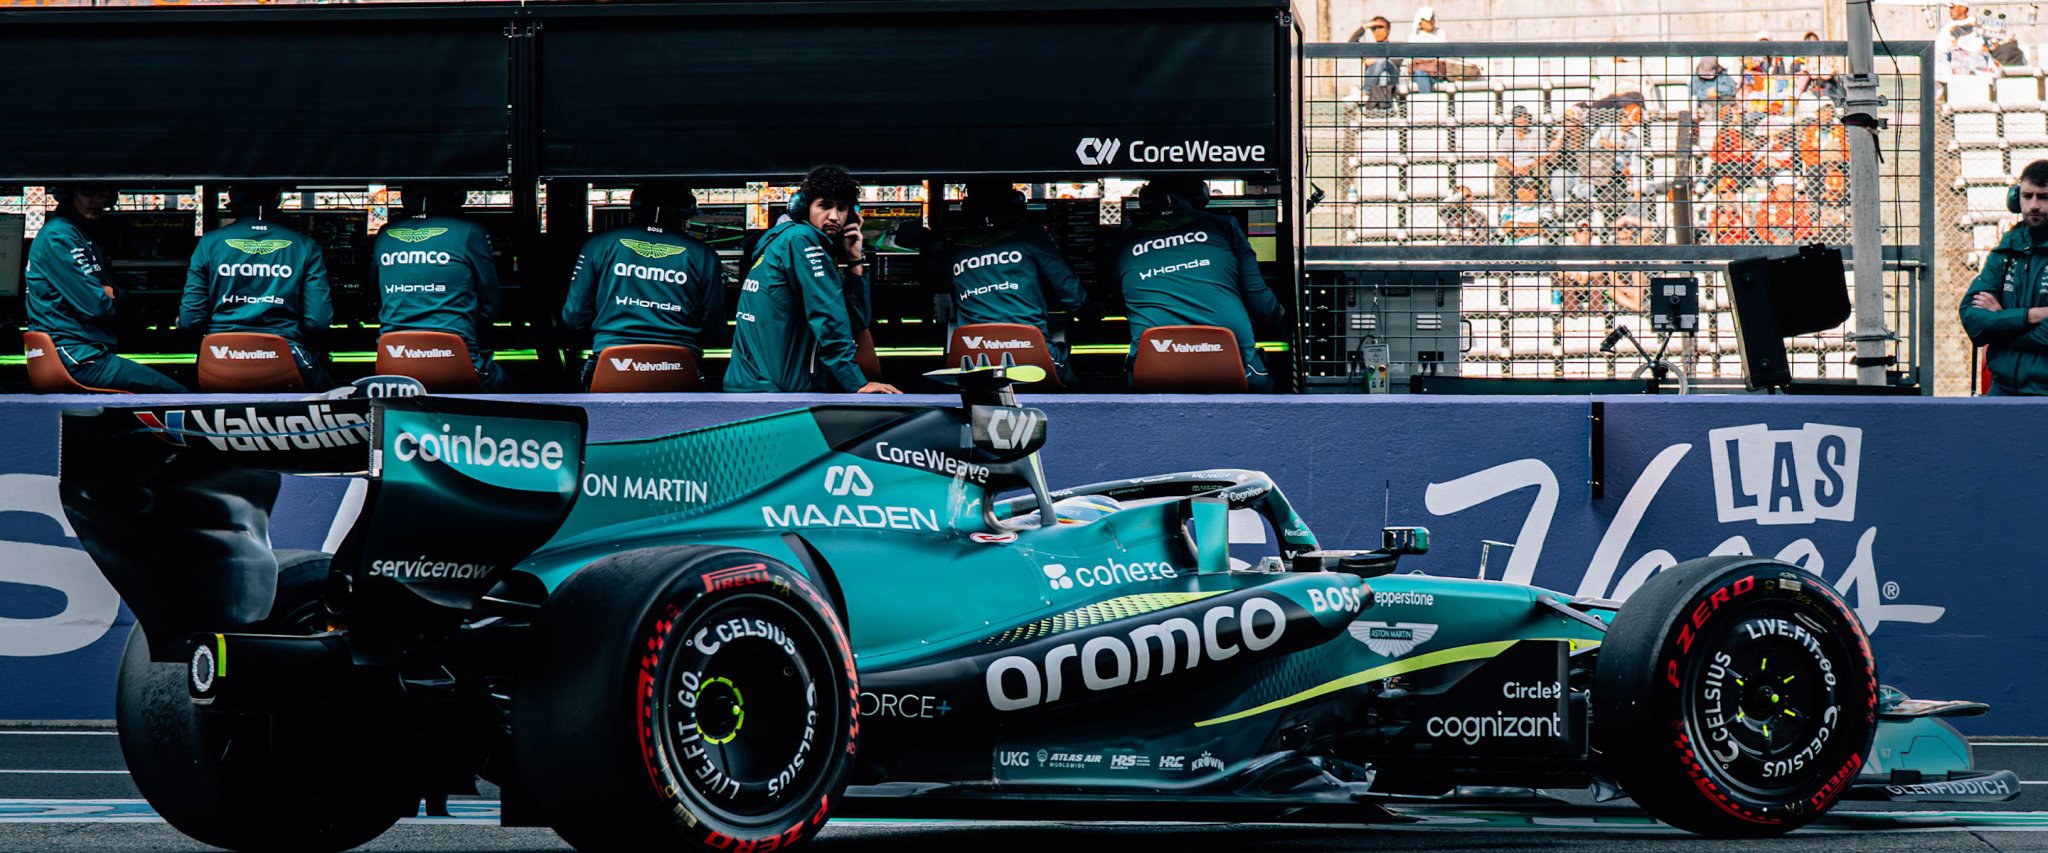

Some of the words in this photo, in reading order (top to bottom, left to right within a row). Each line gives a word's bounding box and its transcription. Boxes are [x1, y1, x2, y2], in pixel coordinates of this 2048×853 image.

[1129, 140, 1266, 163] CoreWeave
[1132, 231, 1208, 257] aramco
[381, 250, 450, 266] aramco
[952, 250, 1022, 276] aramco
[1153, 258, 1210, 277] Honda
[218, 262, 292, 279] aramco
[614, 262, 688, 285] aramco
[394, 283, 446, 292] Honda
[742, 278, 760, 293] mco
[967, 281, 1019, 296] Honda
[235, 294, 284, 304] Honda
[628, 297, 682, 312] Honda
[367, 382, 419, 398] arm
[393, 424, 564, 470] coinbase
[875, 442, 990, 484] CoreWeave
[1727, 437, 1845, 512] LAS
[624, 477, 708, 504] MARTIN
[1230, 487, 1264, 501] Cognition
[761, 505, 941, 532] MAADEN
[1284, 528, 1308, 537] NexGen
[368, 553, 495, 580] servicenow
[701, 563, 769, 593] PIRELLI
[1075, 557, 1178, 588] cohere
[1307, 587, 1359, 613] BOSS
[1374, 590, 1433, 606] epperstone
[715, 618, 796, 655] CELSIUS
[1371, 629, 1390, 637] ASTON
[1391, 630, 1412, 638] MARTIN
[1667, 660, 1680, 688] P
[1677, 575, 1754, 654] ZERO
[986, 597, 1286, 711] aramco
[1503, 681, 1551, 699] Circle
[1704, 652, 1731, 742] CELSIUS
[860, 691, 951, 719] ORCE+
[1427, 711, 1561, 745] cognizant
[768, 711, 817, 797] CELSIUS
[1001, 752, 1029, 766] UKG
[1050, 753, 1083, 761] ATLAS
[1111, 755, 1137, 766] HRS
[1159, 756, 1185, 768] HRC
[1191, 756, 1225, 772] KROWN
[1762, 727, 1830, 778] CELSIUS
[1811, 753, 1862, 811] PIRELLI
[1886, 780, 2010, 797] GLENFIDDICH
[704, 820, 805, 853] ZERO
